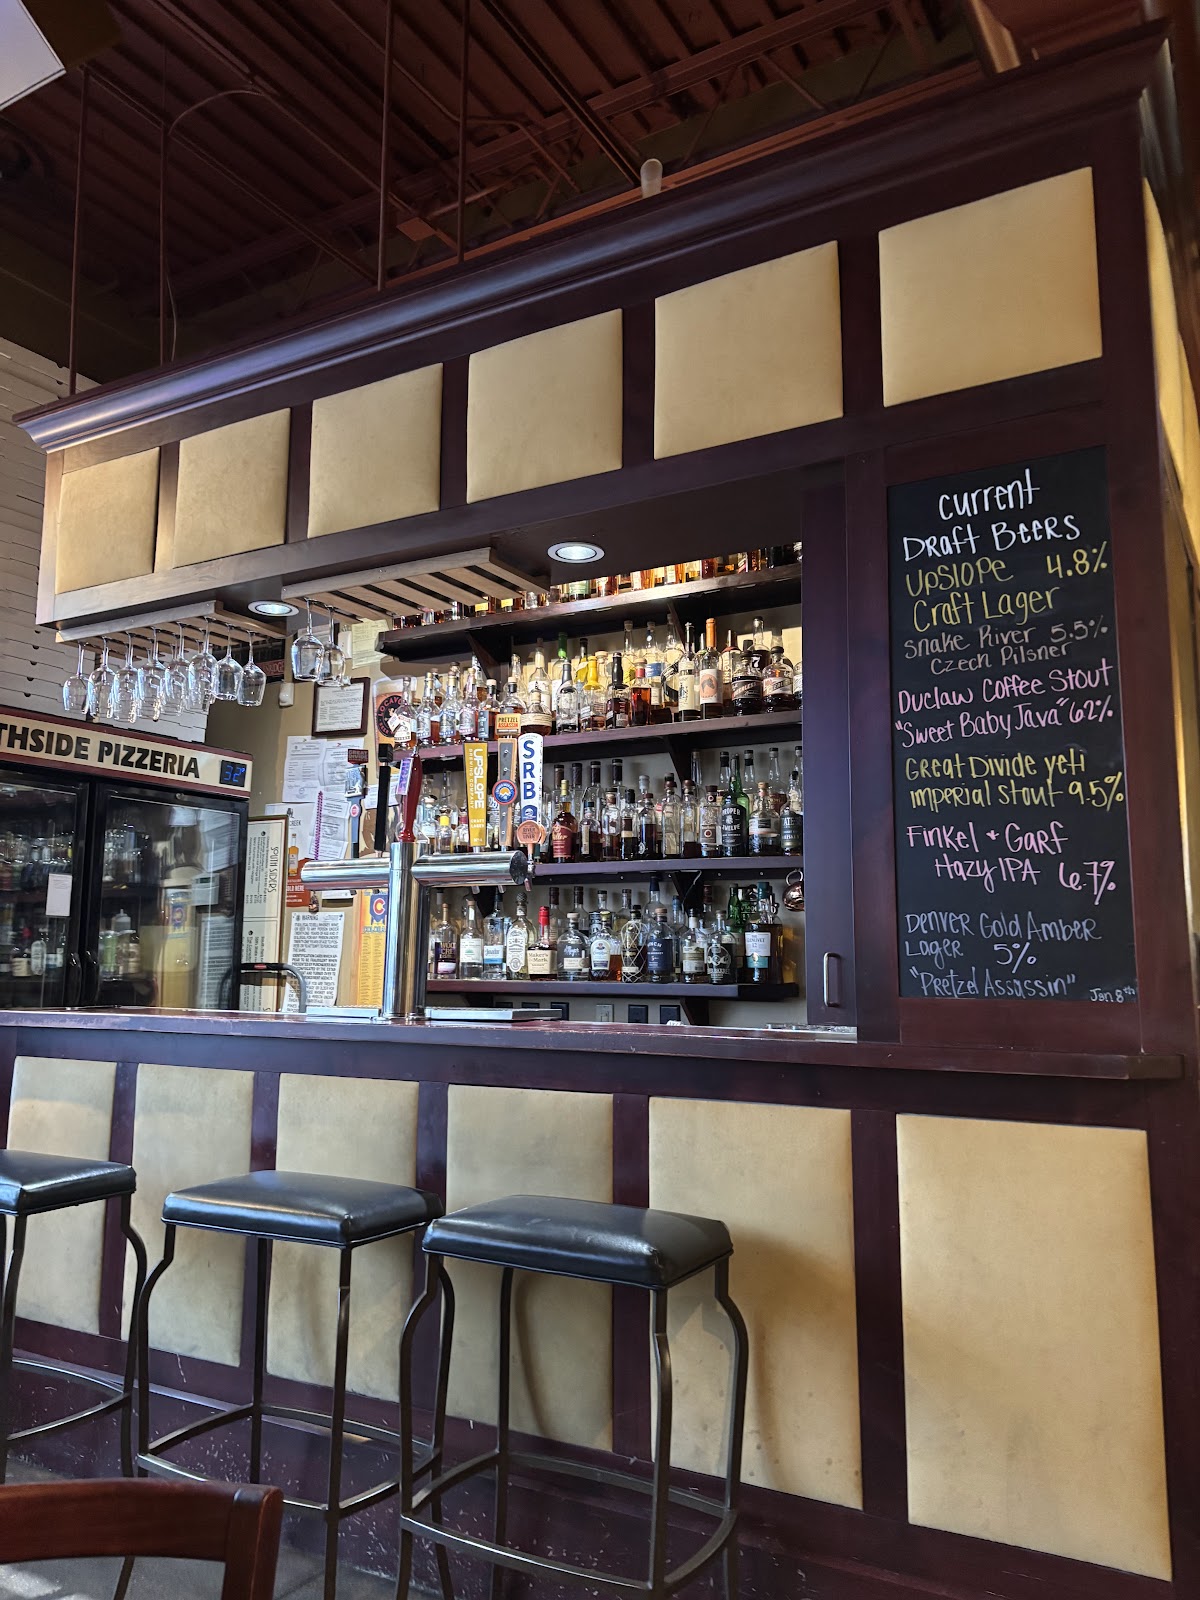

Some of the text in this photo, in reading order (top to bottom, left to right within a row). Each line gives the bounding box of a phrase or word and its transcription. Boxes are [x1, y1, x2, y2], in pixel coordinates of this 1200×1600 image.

[1047, 541, 1108, 578] 4.8%
[913, 587, 1060, 632] Craft Lager
[979, 625, 1037, 648] River
[1050, 615, 1108, 643] 5.5%
[1000, 641, 1072, 666] Pilsner
[983, 674, 1046, 702] Coffee
[1049, 658, 1113, 692] Stout
[959, 710, 1011, 740] Baby
[97, 740, 200, 779] PIZZERIA
[967, 752, 1037, 779] Divide
[473, 748, 485, 809] UPSLOPE
[1068, 771, 1124, 812] 9.5%
[998, 857, 1041, 886] IPA
[979, 912, 1023, 939] Gold
[993, 942, 1037, 974] 5%
